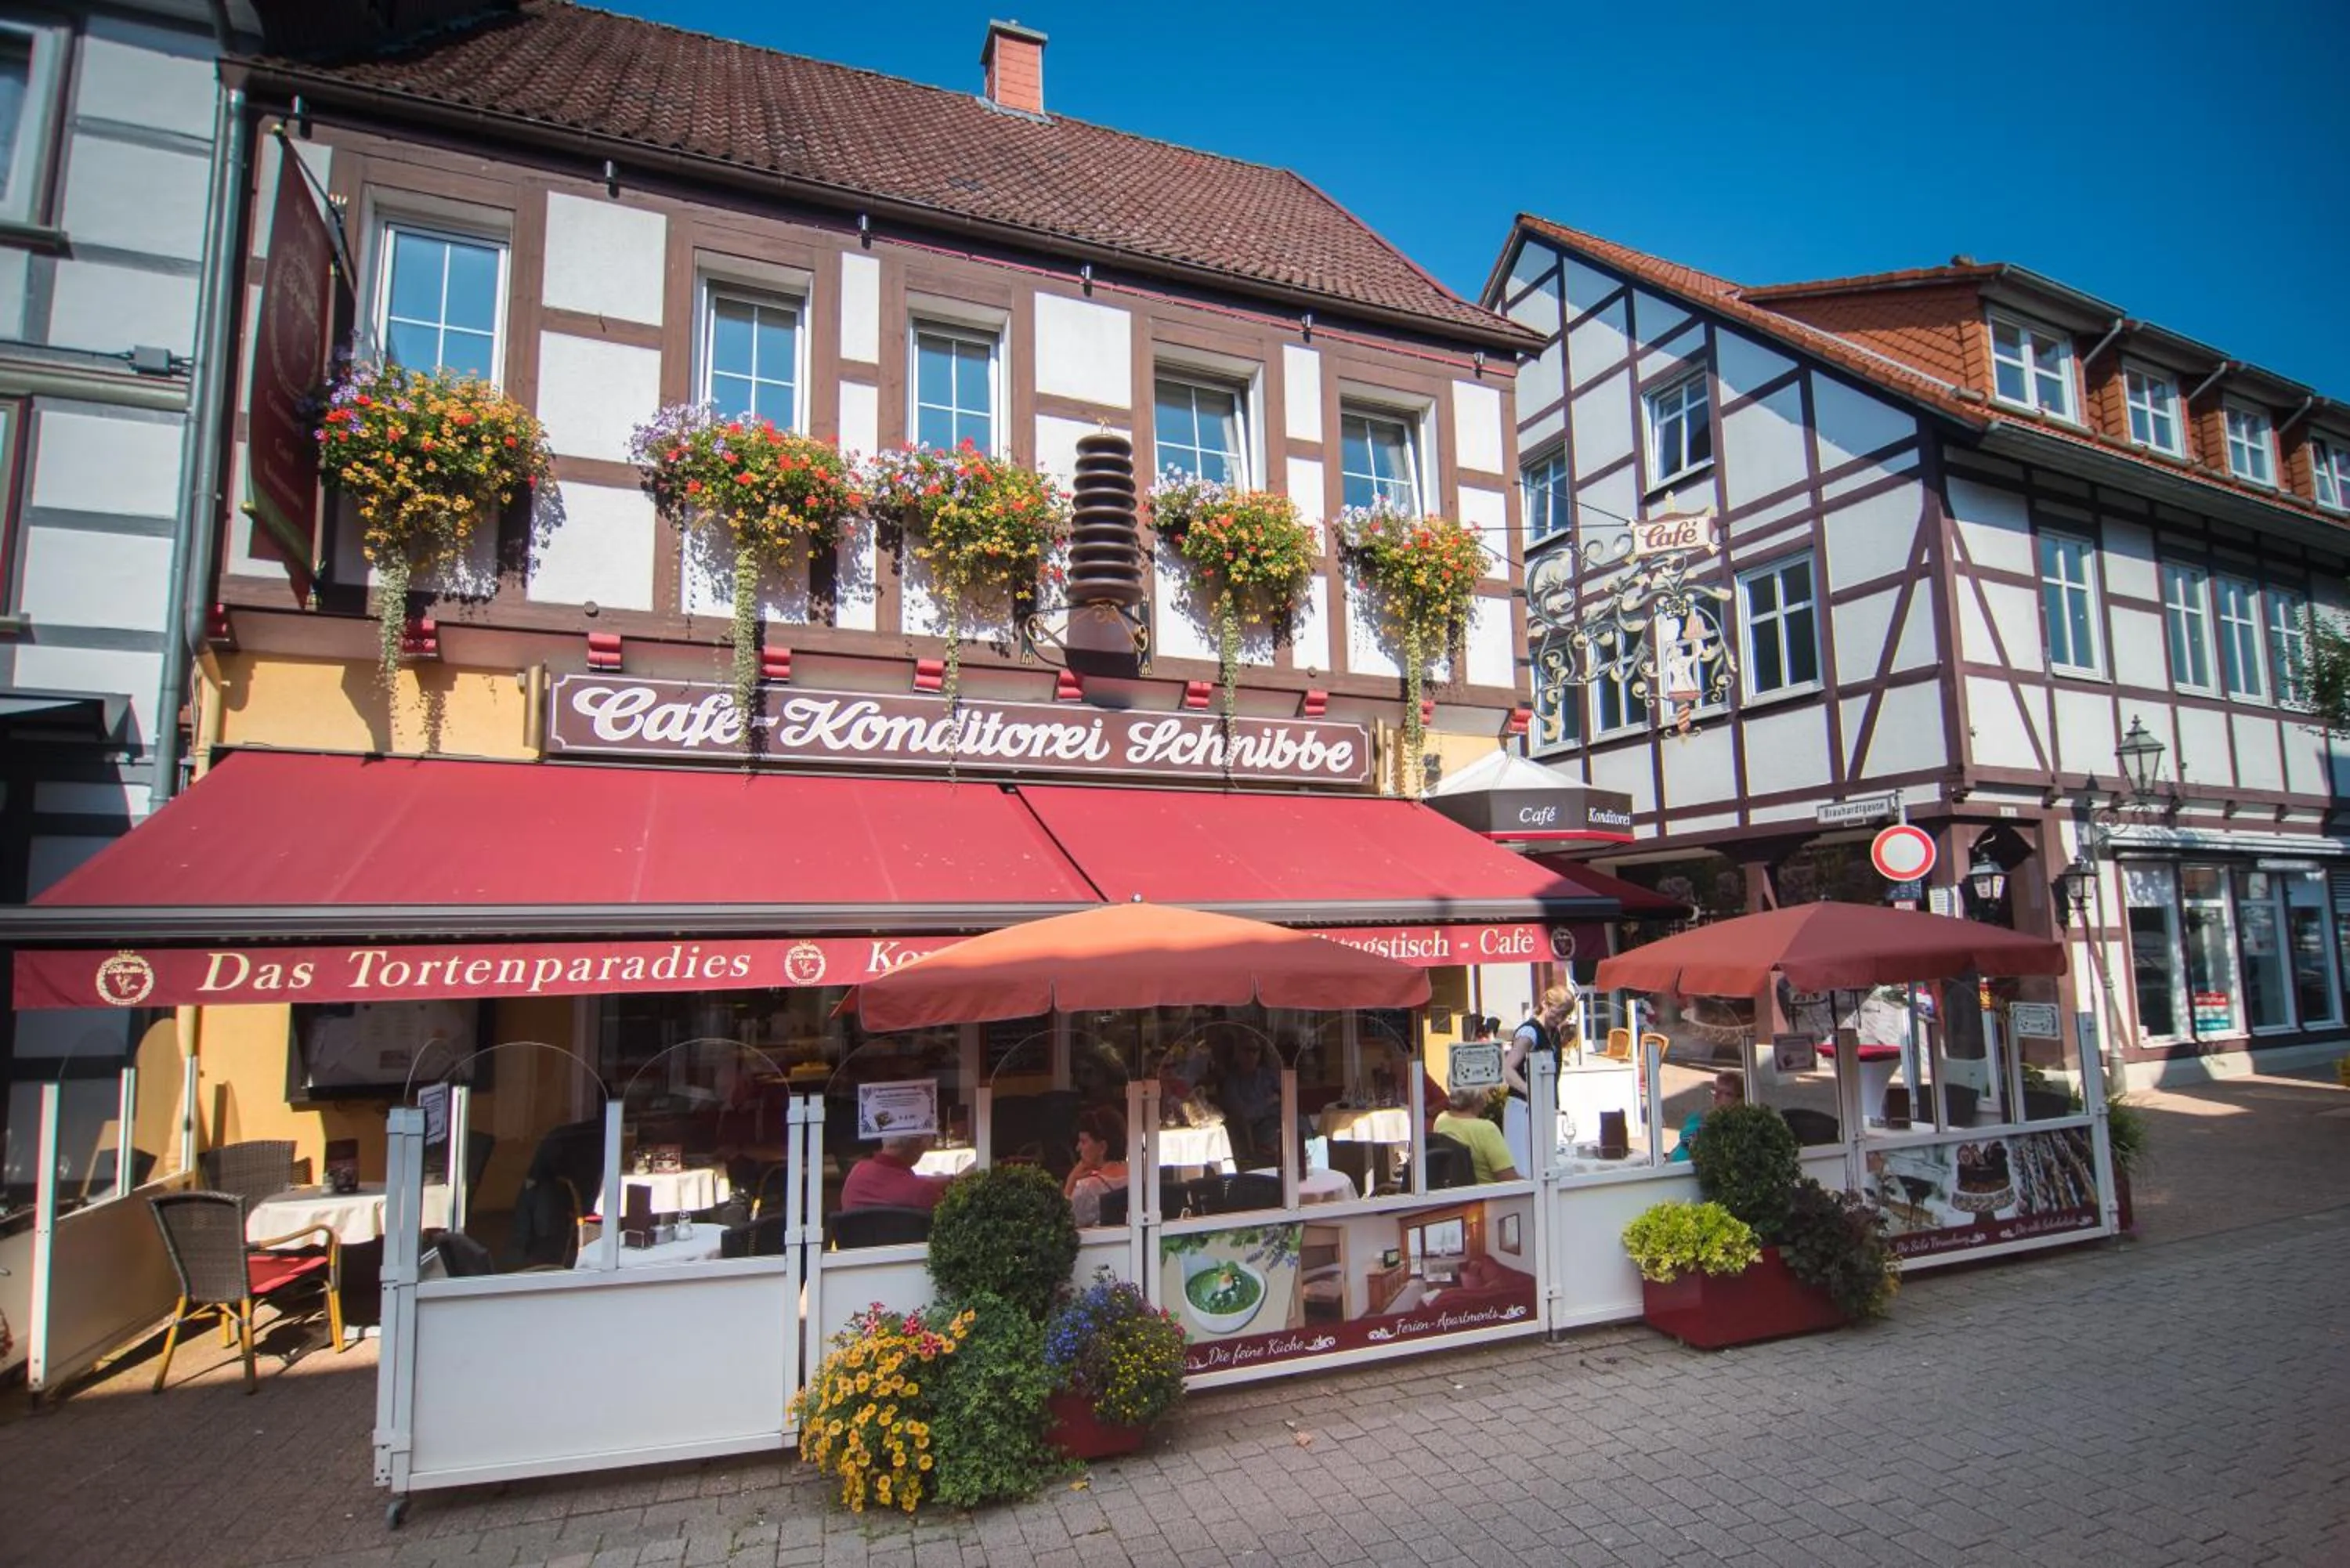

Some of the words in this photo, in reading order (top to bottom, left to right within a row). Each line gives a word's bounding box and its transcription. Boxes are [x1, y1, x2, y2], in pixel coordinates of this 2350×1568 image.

[1639, 520, 1697, 547] Café
[1126, 718, 1353, 771] Schnibbe
[1519, 806, 1556, 826] Café
[1588, 807, 1630, 826] Konditorei
[196, 952, 315, 991] Das
[347, 945, 752, 993] Tortenparadies
[1396, 1306, 1499, 1336] Ferien-Apartments
[1209, 1346, 1231, 1365] Die
[1231, 1342, 1264, 1365] feine
[1267, 1335, 1304, 1356] Küche
